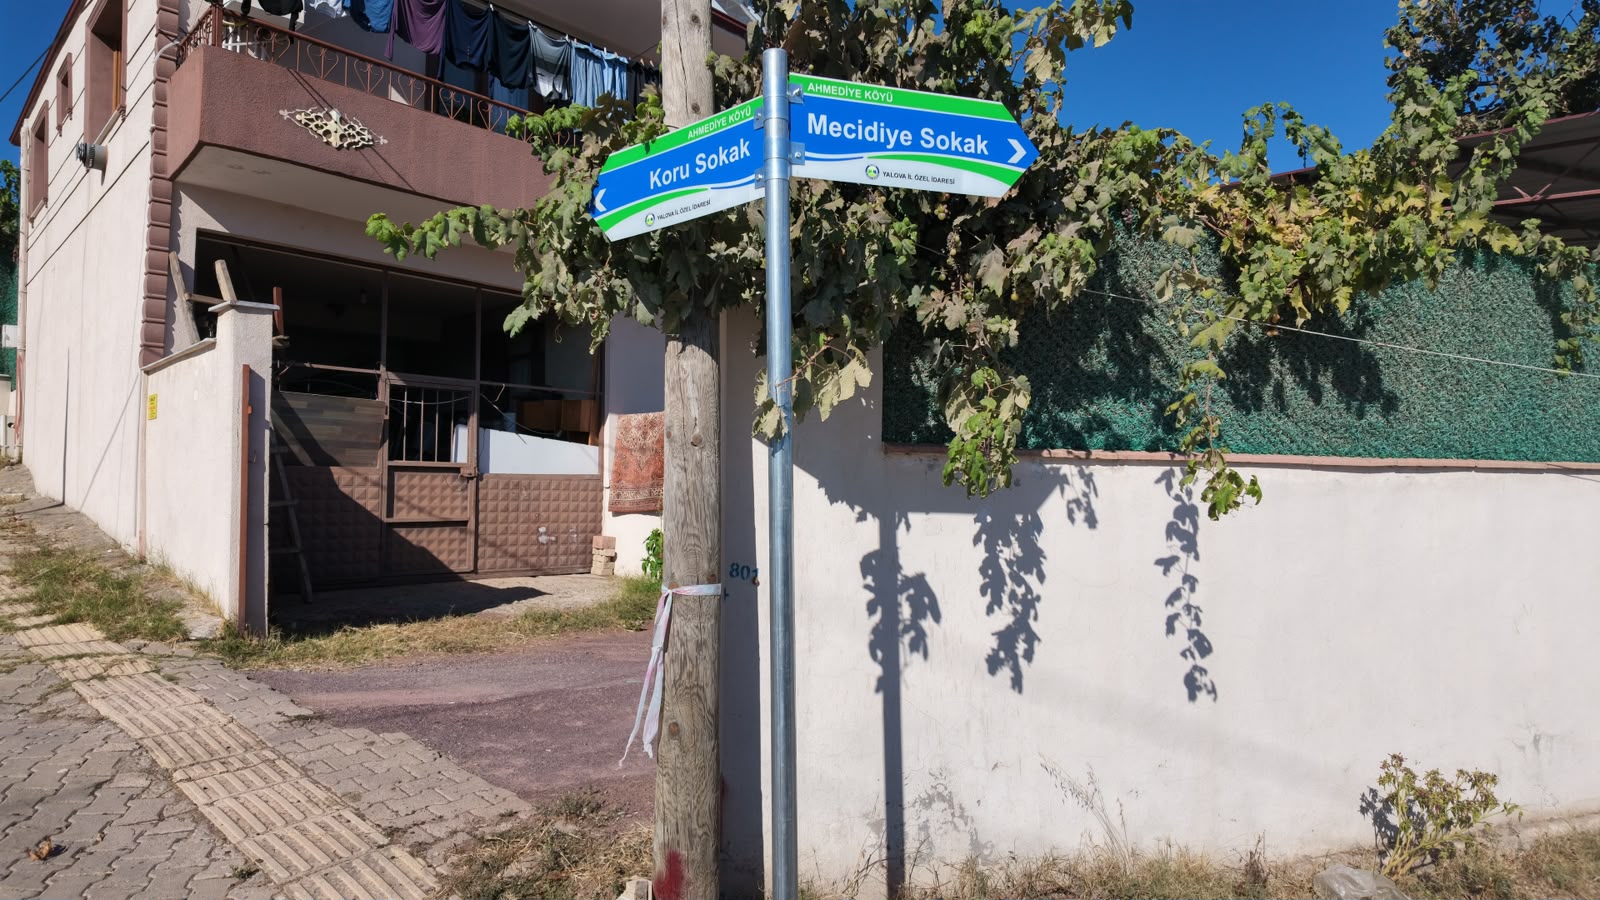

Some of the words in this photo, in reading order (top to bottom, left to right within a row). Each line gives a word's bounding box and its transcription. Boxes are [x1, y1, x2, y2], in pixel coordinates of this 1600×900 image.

[807, 82, 862, 99] AHMEDİYE
[864, 90, 893, 103] KÖYÜ
[687, 116, 727, 140] AHMEDİYE
[728, 104, 752, 124] KÖYÜ
[807, 112, 913, 149] Mecidiye
[920, 127, 989, 155] Sokak
[649, 163, 690, 190] Koru
[695, 138, 751, 174] Sokak
[882, 171, 907, 179] YALOVA
[914, 174, 930, 182] ÖZEL
[656, 211, 675, 220] YALOVA
